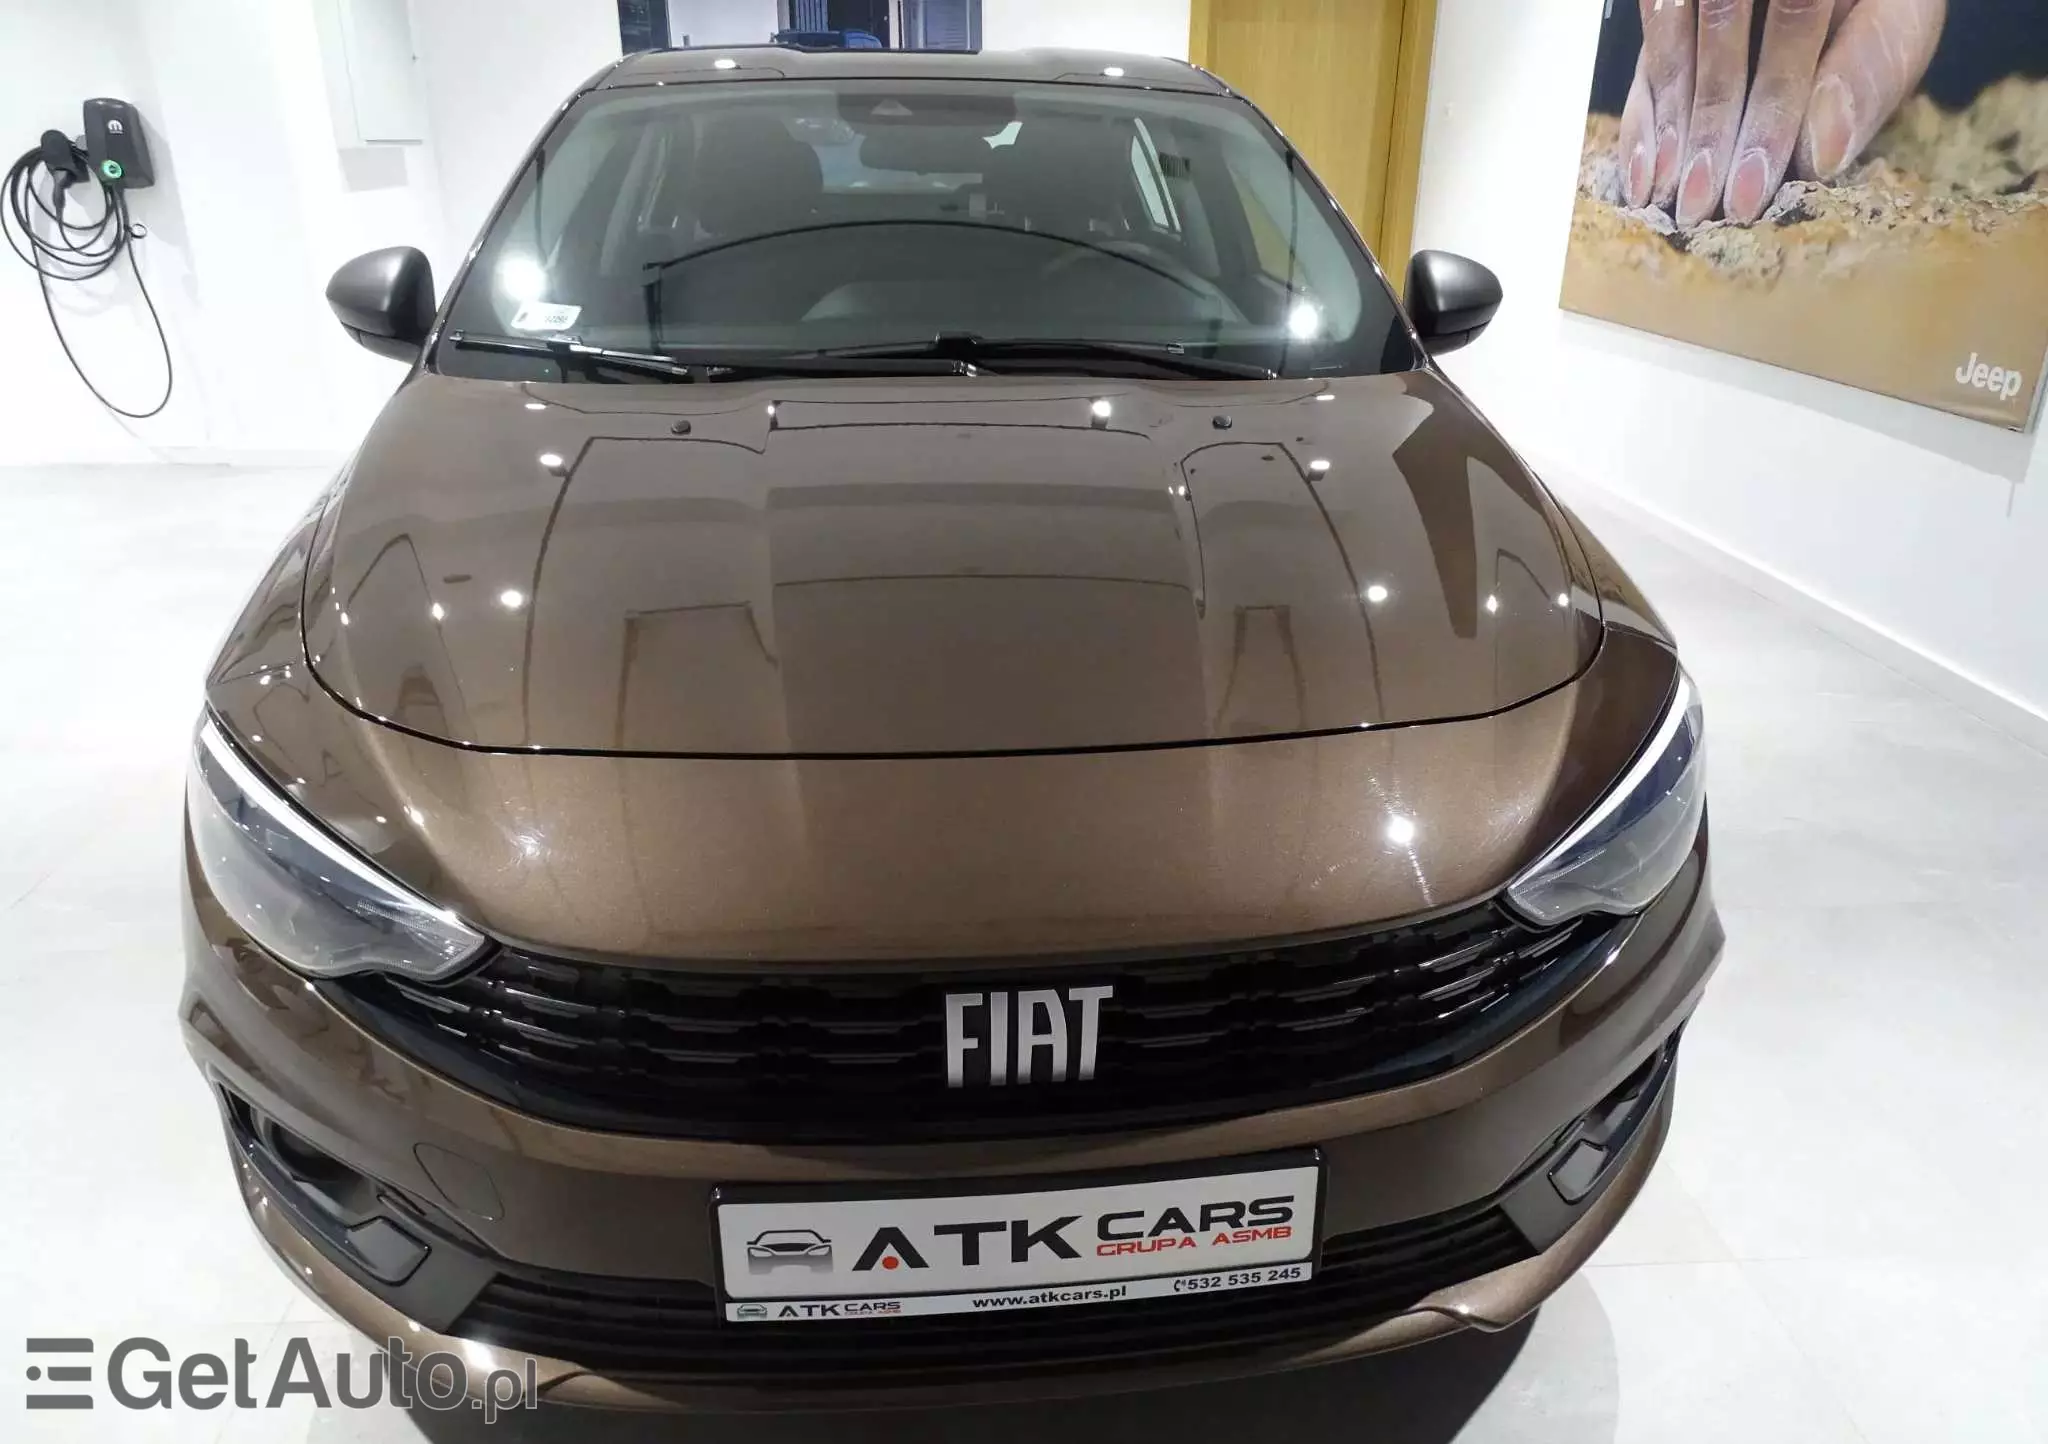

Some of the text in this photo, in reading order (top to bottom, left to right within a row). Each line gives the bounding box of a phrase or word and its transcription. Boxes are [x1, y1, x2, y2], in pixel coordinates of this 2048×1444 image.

[1955, 352, 2022, 400] Jeep
[946, 985, 1113, 1087] FIAT
[852, 1195, 1294, 1272] ATK CARS
[1097, 1226, 1292, 1256] GRUPA ASMB
[1187, 1267, 1301, 1290] 532 535 245
[778, 1304, 841, 1317] ATK
[844, 1301, 901, 1312] CARS
[972, 1285, 1127, 1308] www.atkcars.pl
